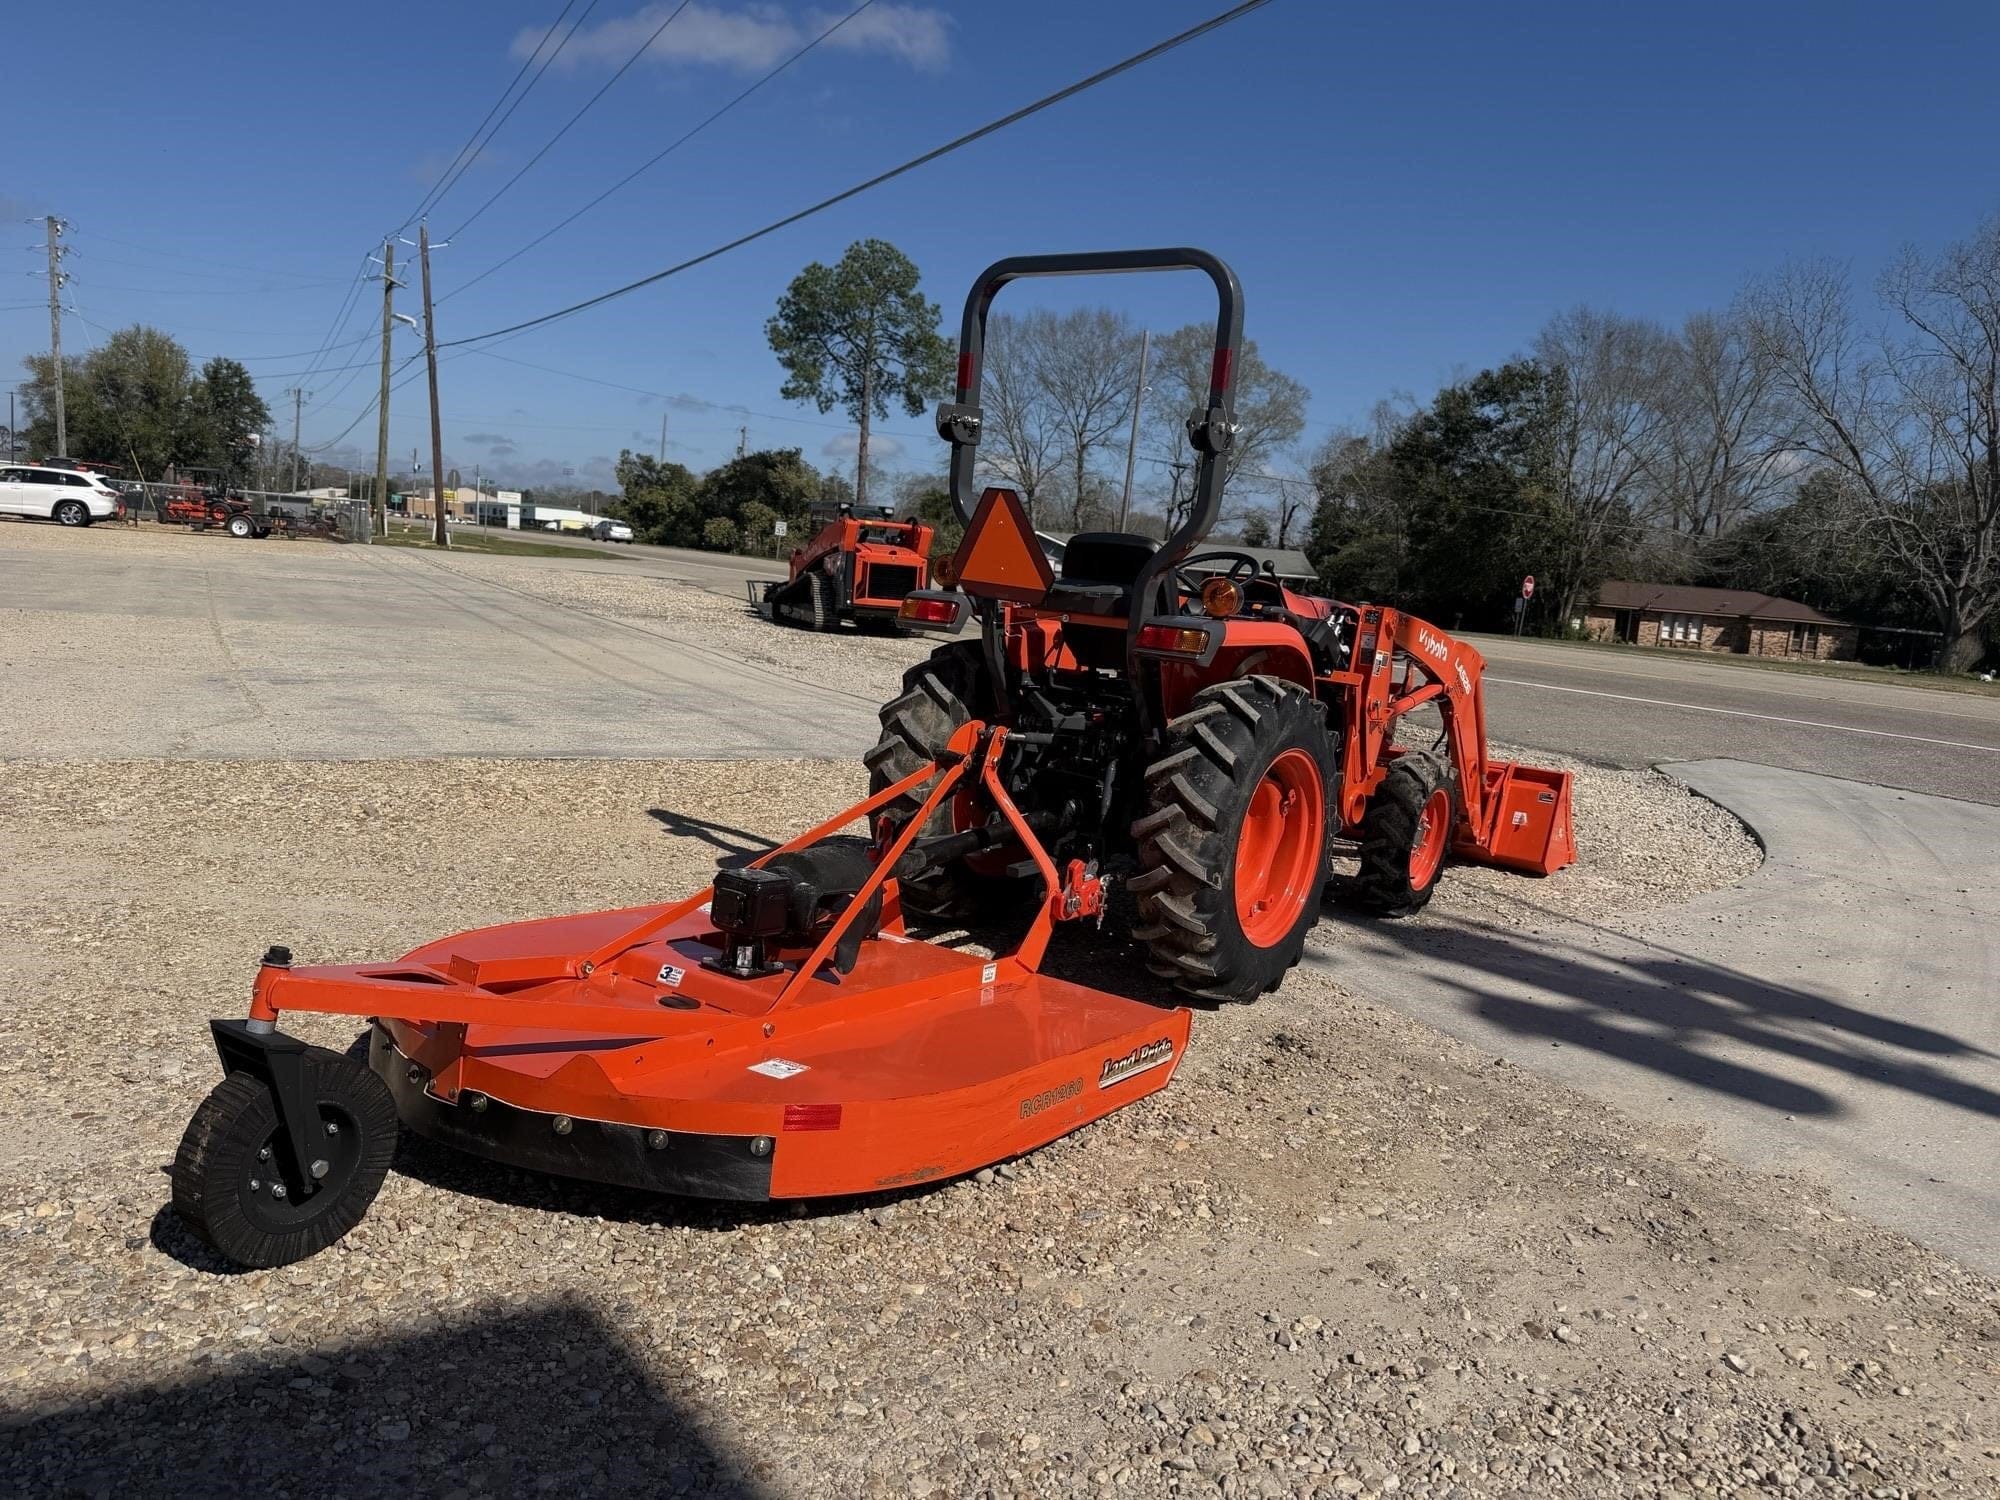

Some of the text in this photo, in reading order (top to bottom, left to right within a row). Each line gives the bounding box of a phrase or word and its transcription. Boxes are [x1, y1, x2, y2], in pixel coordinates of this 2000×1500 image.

[1419, 628, 1448, 661] Kubota
[660, 966, 674, 980] 3
[1019, 1076, 1084, 1120] RCR1260
